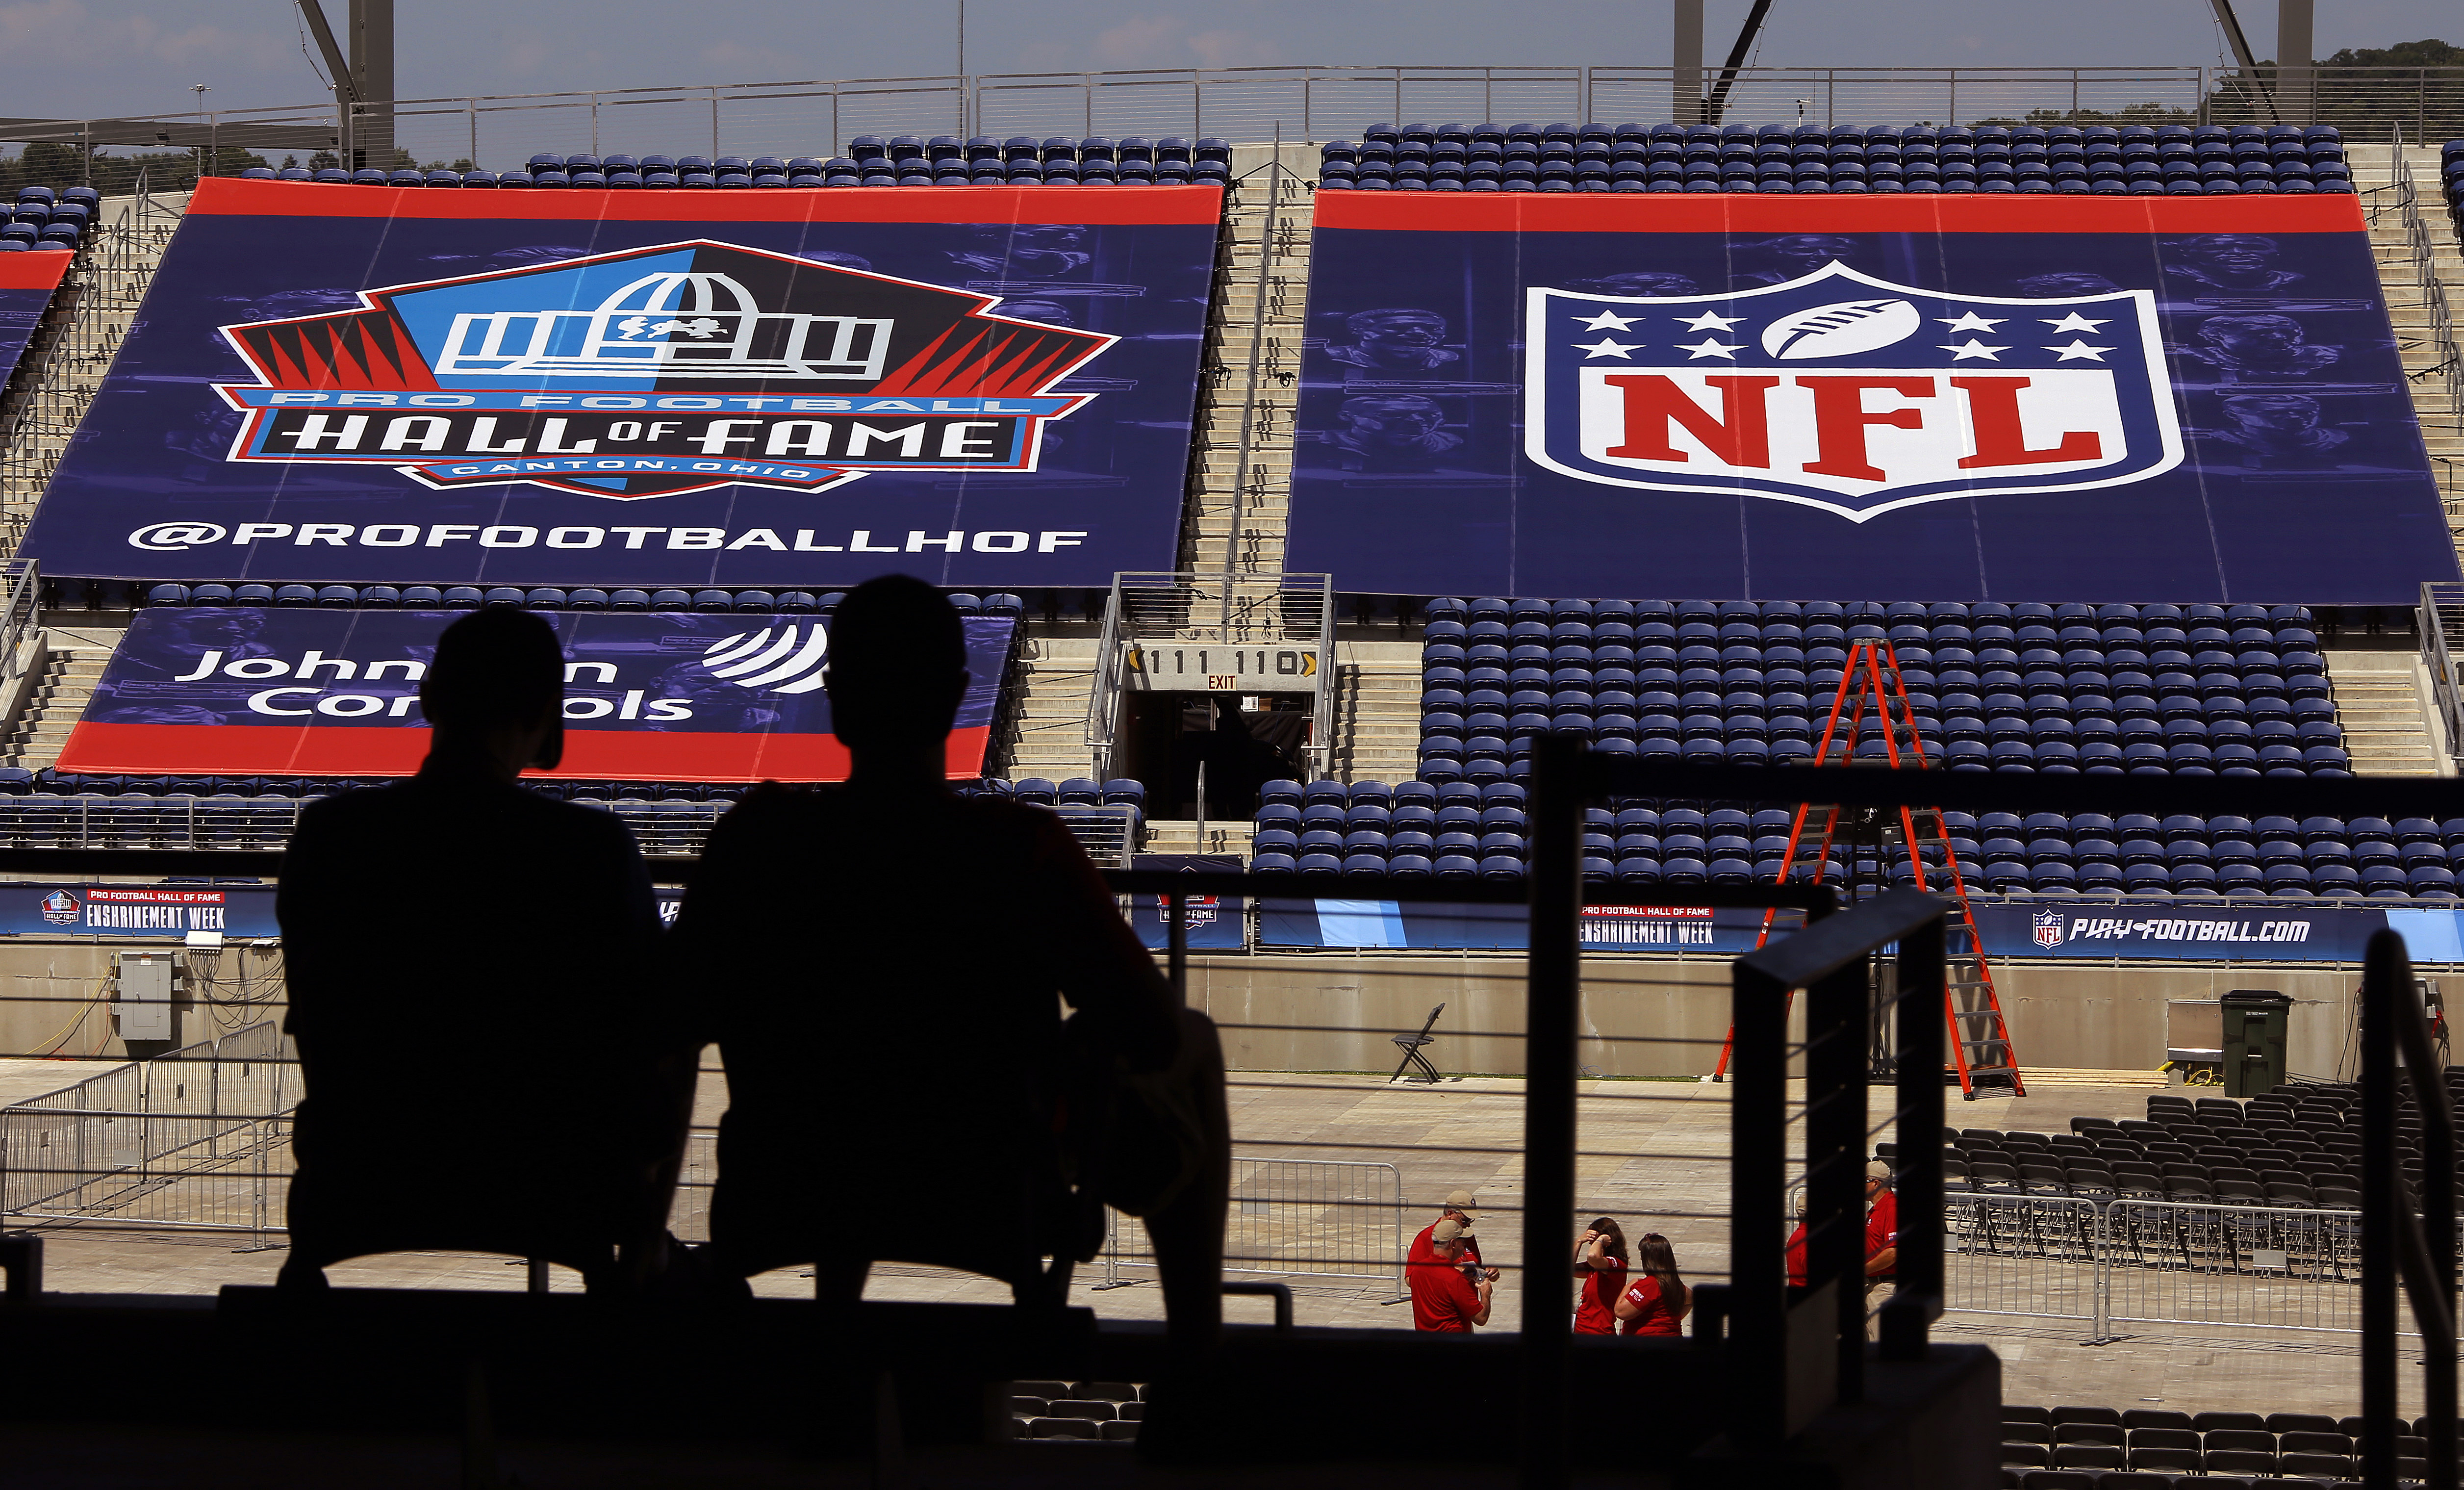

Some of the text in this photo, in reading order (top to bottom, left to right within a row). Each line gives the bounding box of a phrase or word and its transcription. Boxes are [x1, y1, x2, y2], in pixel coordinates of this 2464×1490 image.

[269, 392, 1031, 412] PRO FOOTBALL
[281, 414, 1000, 459] HALL OF FAME
[1604, 374, 2103, 483] NFL
[451, 460, 811, 480] CANTON, OHIO
[127, 521, 1089, 554] @PROFOOTBALLHOF
[174, 650, 617, 684] Johnn
[1151, 650, 1297, 675] 111 110
[1208, 675, 1236, 690] EXIT
[90, 890, 108, 899] PRO
[111, 892, 155, 900] FOOTBALL
[157, 893, 181, 901] HALL
[87, 904, 225, 929] ENSHRINEMENT WEEK
[1191, 910, 1214, 919] FAME
[1602, 907, 1645, 915] FOOTBALL
[1648, 907, 1671, 916] HALL
[1579, 920, 1714, 944] ENSHRINEMENT WEEK
[2037, 927, 2060, 944] NFL
